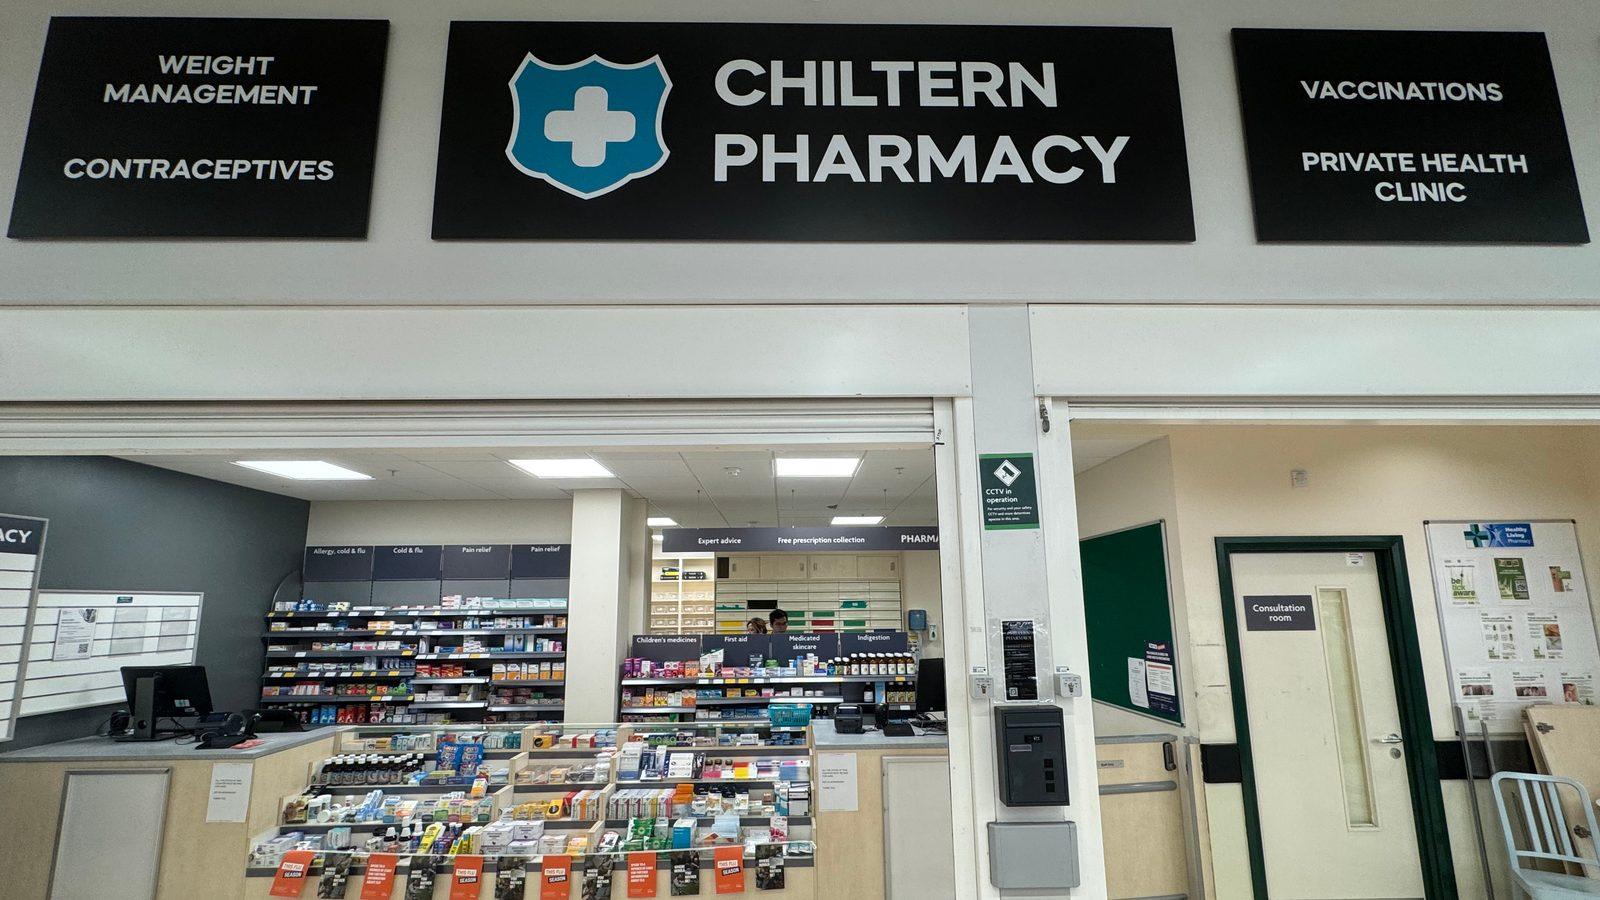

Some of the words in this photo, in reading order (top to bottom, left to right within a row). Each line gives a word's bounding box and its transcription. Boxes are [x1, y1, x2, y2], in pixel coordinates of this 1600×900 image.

[158, 54, 275, 77] WEIGHT
[714, 59, 1058, 109] CHILTERN
[1300, 80, 1504, 102] VACCINATIONS
[103, 83, 319, 106] MANAGEMENT
[714, 133, 1131, 185] PHARMACY
[1301, 152, 1417, 172] PRIVATE
[1420, 153, 1529, 174] HEALTH
[63, 158, 335, 182] CONTRACEPTIVES
[1374, 181, 1468, 203] CLINIC
[985, 488, 1004, 496] CCTV
[986, 496, 1018, 505] operation
[698, 537, 720, 546] Expert
[720, 537, 742, 545] advice
[777, 537, 792, 545] Free
[792, 537, 832, 546] prescription
[832, 536, 866, 544] collection
[313, 548, 336, 556] Allergy,
[1450, 577, 1461, 585] be
[1252, 603, 1306, 612] Consultation
[857, 634, 891, 642] Indigestion
